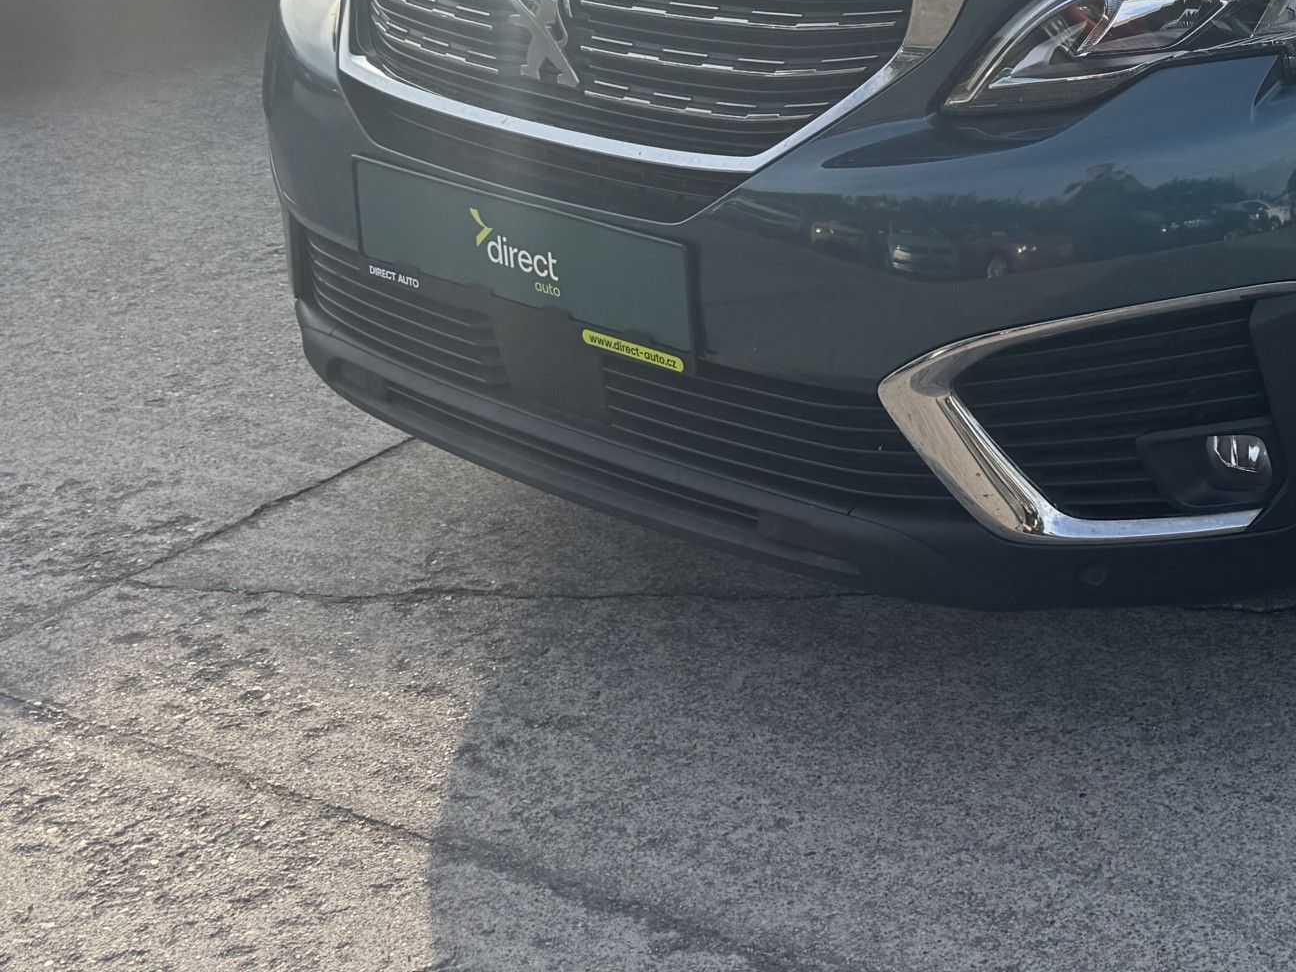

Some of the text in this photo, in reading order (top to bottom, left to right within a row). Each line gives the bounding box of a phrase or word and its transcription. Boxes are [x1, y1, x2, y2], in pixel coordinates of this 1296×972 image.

[486, 235, 559, 281] direct
[368, 265, 420, 289] DIRECT AUTO
[534, 281, 561, 298] auto
[588, 333, 678, 369] www.direct-auto.cz
